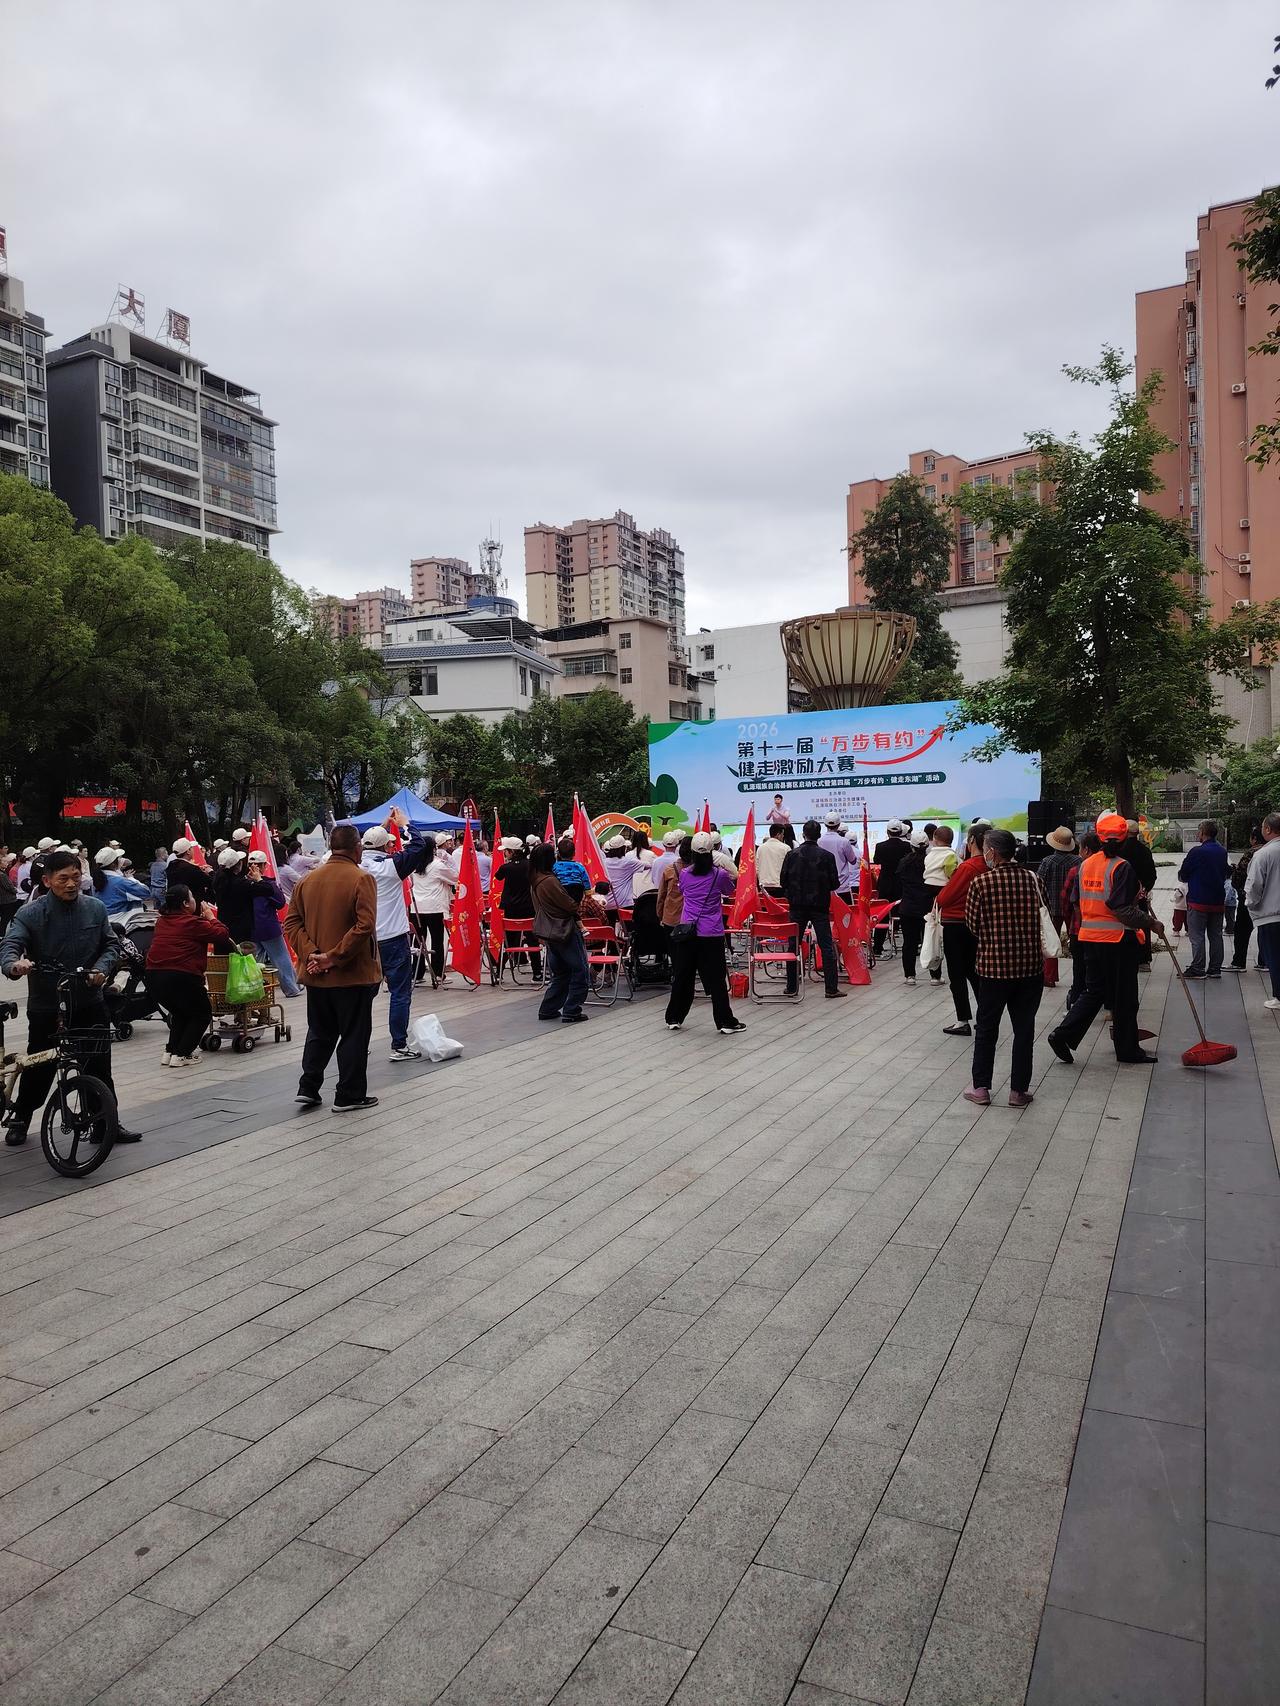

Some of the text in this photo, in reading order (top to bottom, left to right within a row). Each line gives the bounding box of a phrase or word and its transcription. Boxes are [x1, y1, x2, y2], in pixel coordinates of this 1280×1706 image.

[738, 722, 778, 738] 2026
[738, 755, 856, 778] 健走激励大赛
